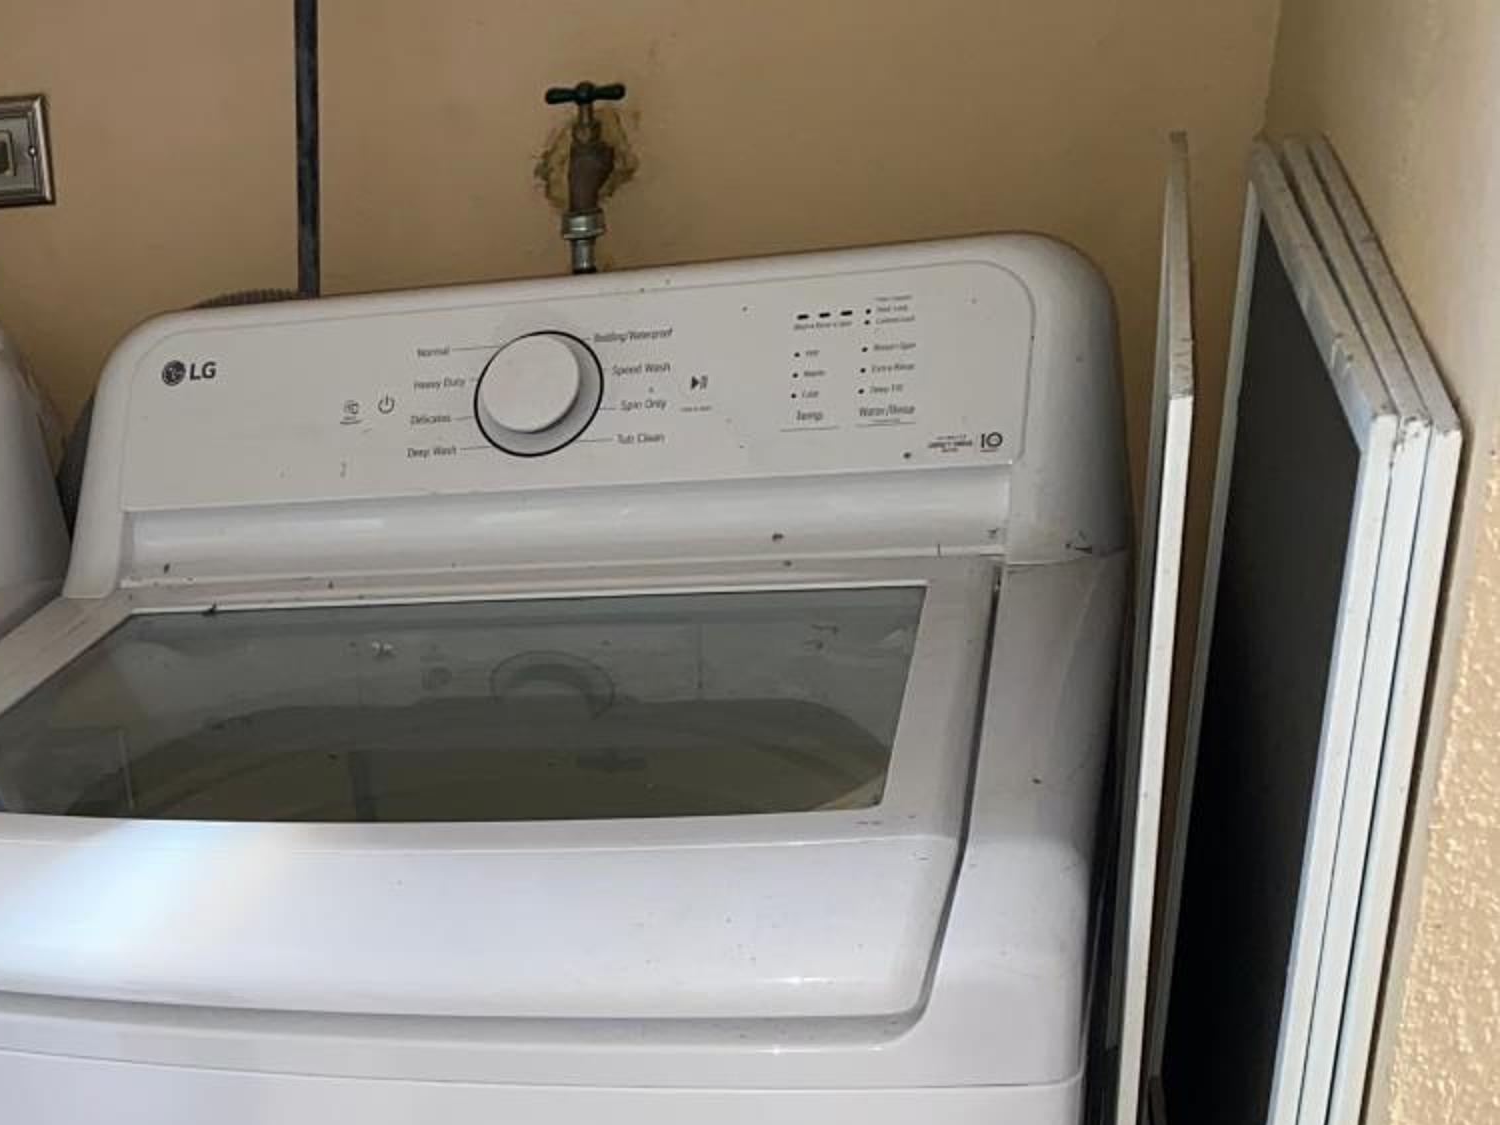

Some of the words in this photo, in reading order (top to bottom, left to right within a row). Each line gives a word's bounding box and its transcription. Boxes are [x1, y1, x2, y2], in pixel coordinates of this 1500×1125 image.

[417, 346, 450, 357] Normal
[190, 362, 217, 381] LG
[612, 364, 642, 376] Speed
[645, 362, 671, 373] Wash
[413, 380, 441, 391] Heavy
[443, 377, 466, 388] Duty
[621, 399, 642, 411] Spin
[645, 398, 667, 410] Only
[410, 415, 452, 425] Delicates
[617, 433, 635, 444] Tub
[637, 432, 665, 444] Clean
[407, 447, 430, 459] Deep
[433, 445, 457, 456] Wash
